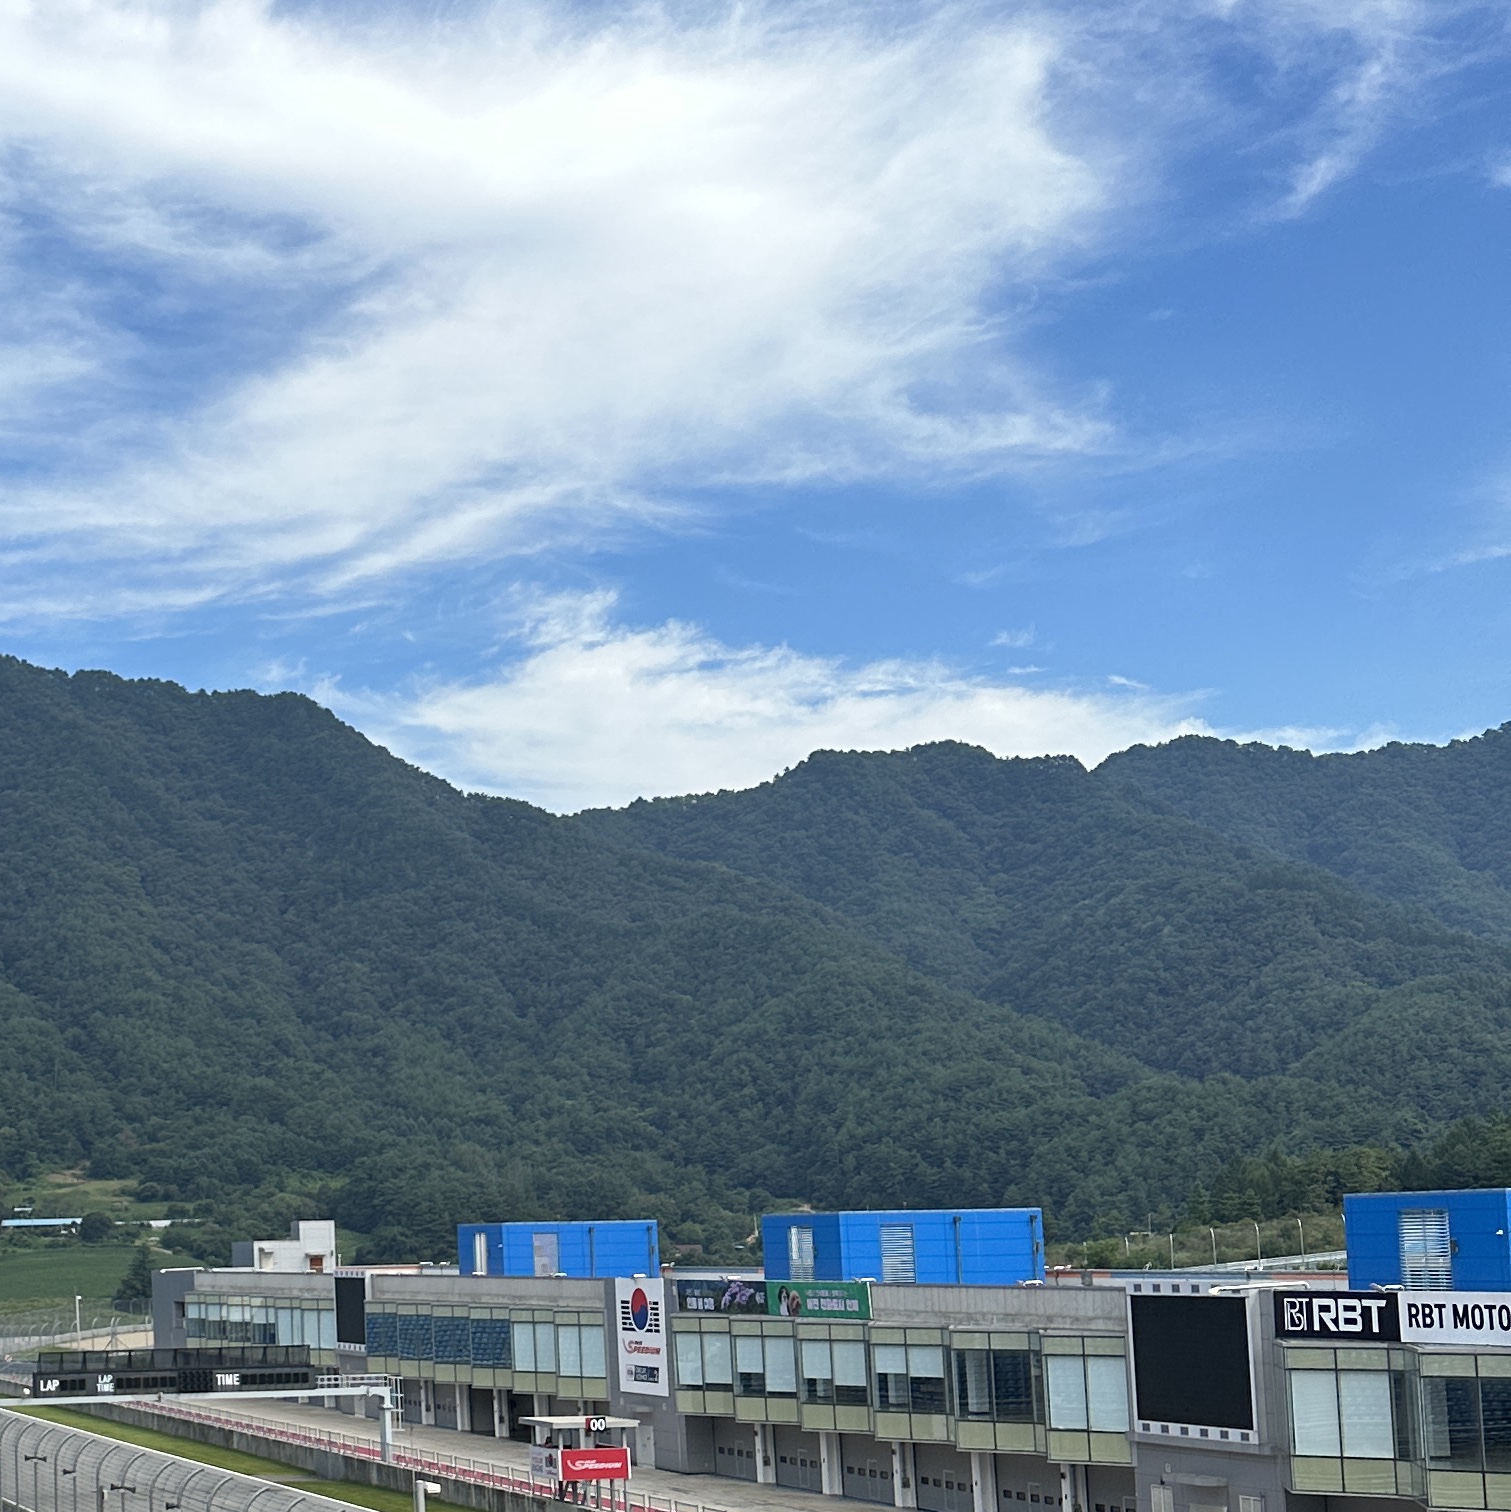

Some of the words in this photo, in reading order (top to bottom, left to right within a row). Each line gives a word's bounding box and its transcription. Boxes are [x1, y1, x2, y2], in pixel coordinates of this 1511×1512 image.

[1312, 1298, 1387, 1333] RBT
[1407, 1303, 1446, 1328] RBT
[1452, 1303, 1511, 1331] MOTO
[97, 1374, 113, 1383] LAP
[215, 1373, 240, 1386] TIME
[39, 1379, 60, 1392] LAP
[96, 1383, 115, 1392] TIME
[589, 1418, 606, 1431] 00
